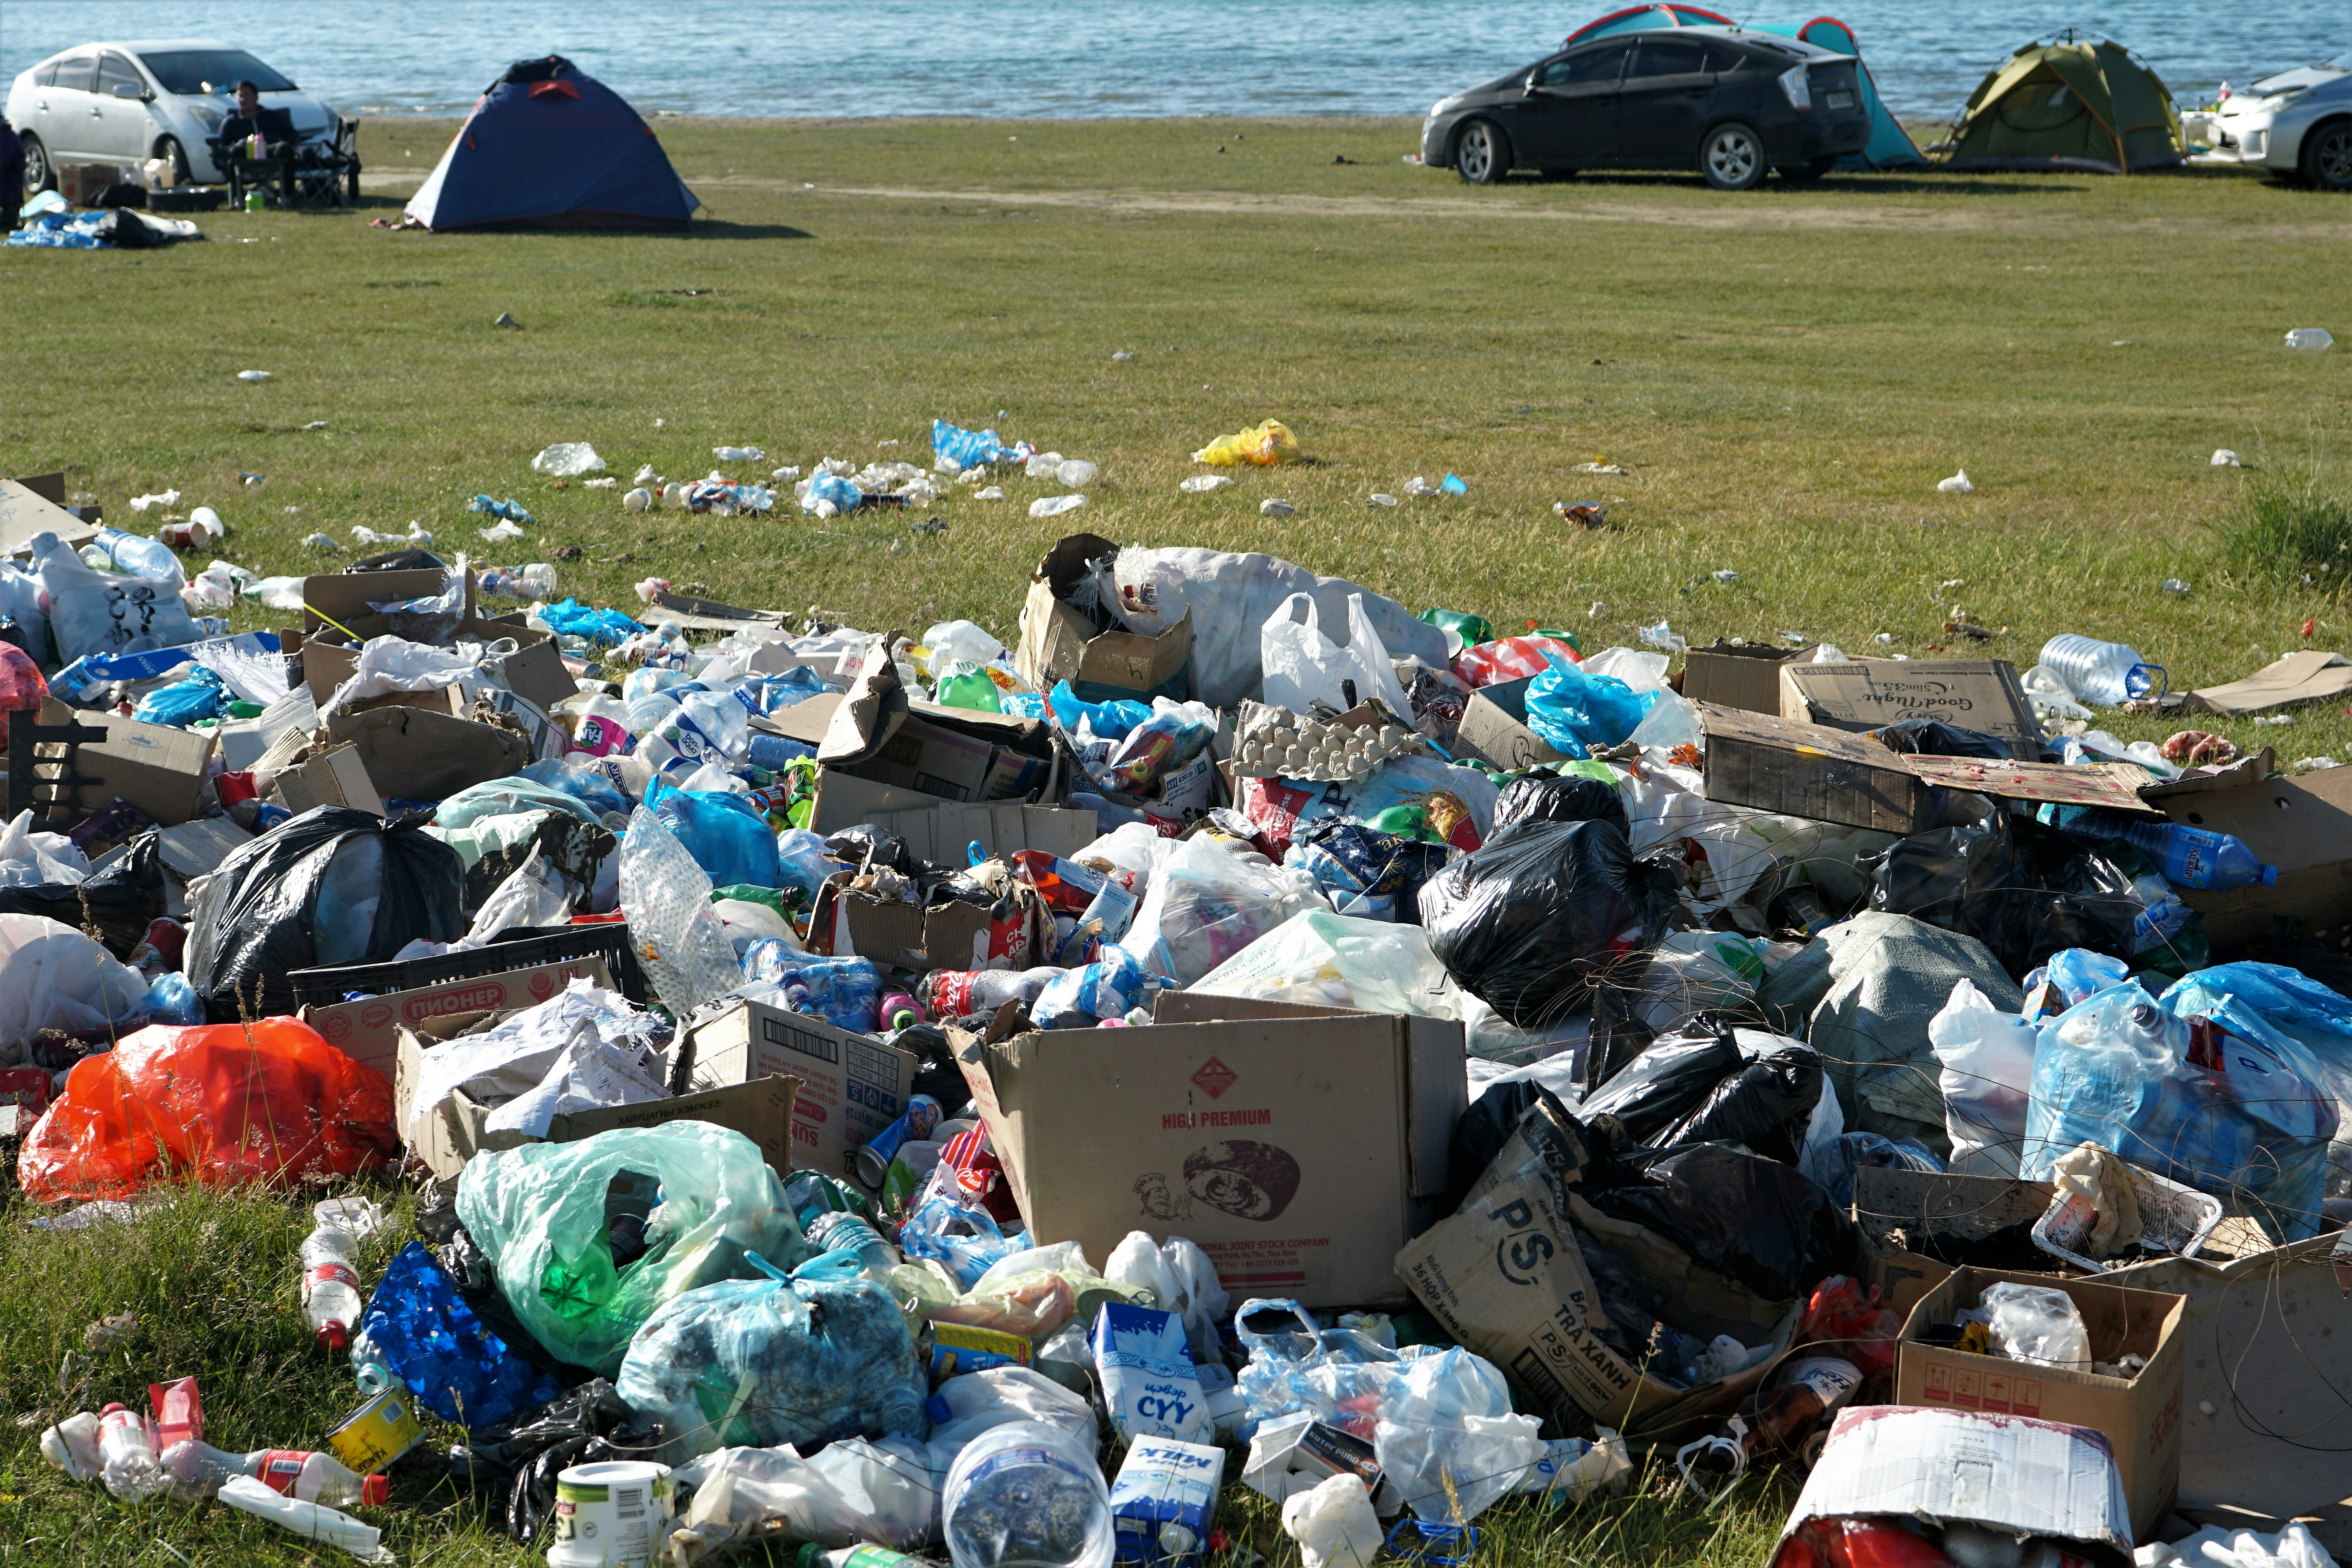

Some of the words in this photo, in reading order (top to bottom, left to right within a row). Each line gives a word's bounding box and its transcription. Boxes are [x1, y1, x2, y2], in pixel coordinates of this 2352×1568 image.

[1863, 692, 1922, 708] Night
[1923, 697, 1973, 711] Good
[681, 738, 696, 754] aqua
[960, 751, 979, 762] B-175
[1073, 781, 1096, 791] HOSEN
[1167, 779, 1177, 789] 621
[412, 989, 499, 1018] ПИОНЕР
[851, 1088, 859, 1100] 5
[618, 1108, 674, 1125] ХАЙРЦАГНЫ
[677, 1100, 723, 1115] ХЭМЖЭЭ:
[1162, 1112, 1197, 1130] HIGH
[1201, 1109, 1271, 1127] PREMIUM
[1230, 1242, 1256, 1251] JOINT
[1258, 1240, 1288, 1249] STOCK
[1290, 1238, 1329, 1247] COMPANY
[1413, 1263, 1426, 1278] 36
[1579, 1338, 1631, 1391] XANH
[1146, 1381, 1187, 1399] цэвэр
[1137, 1447, 1212, 1470] MILK
